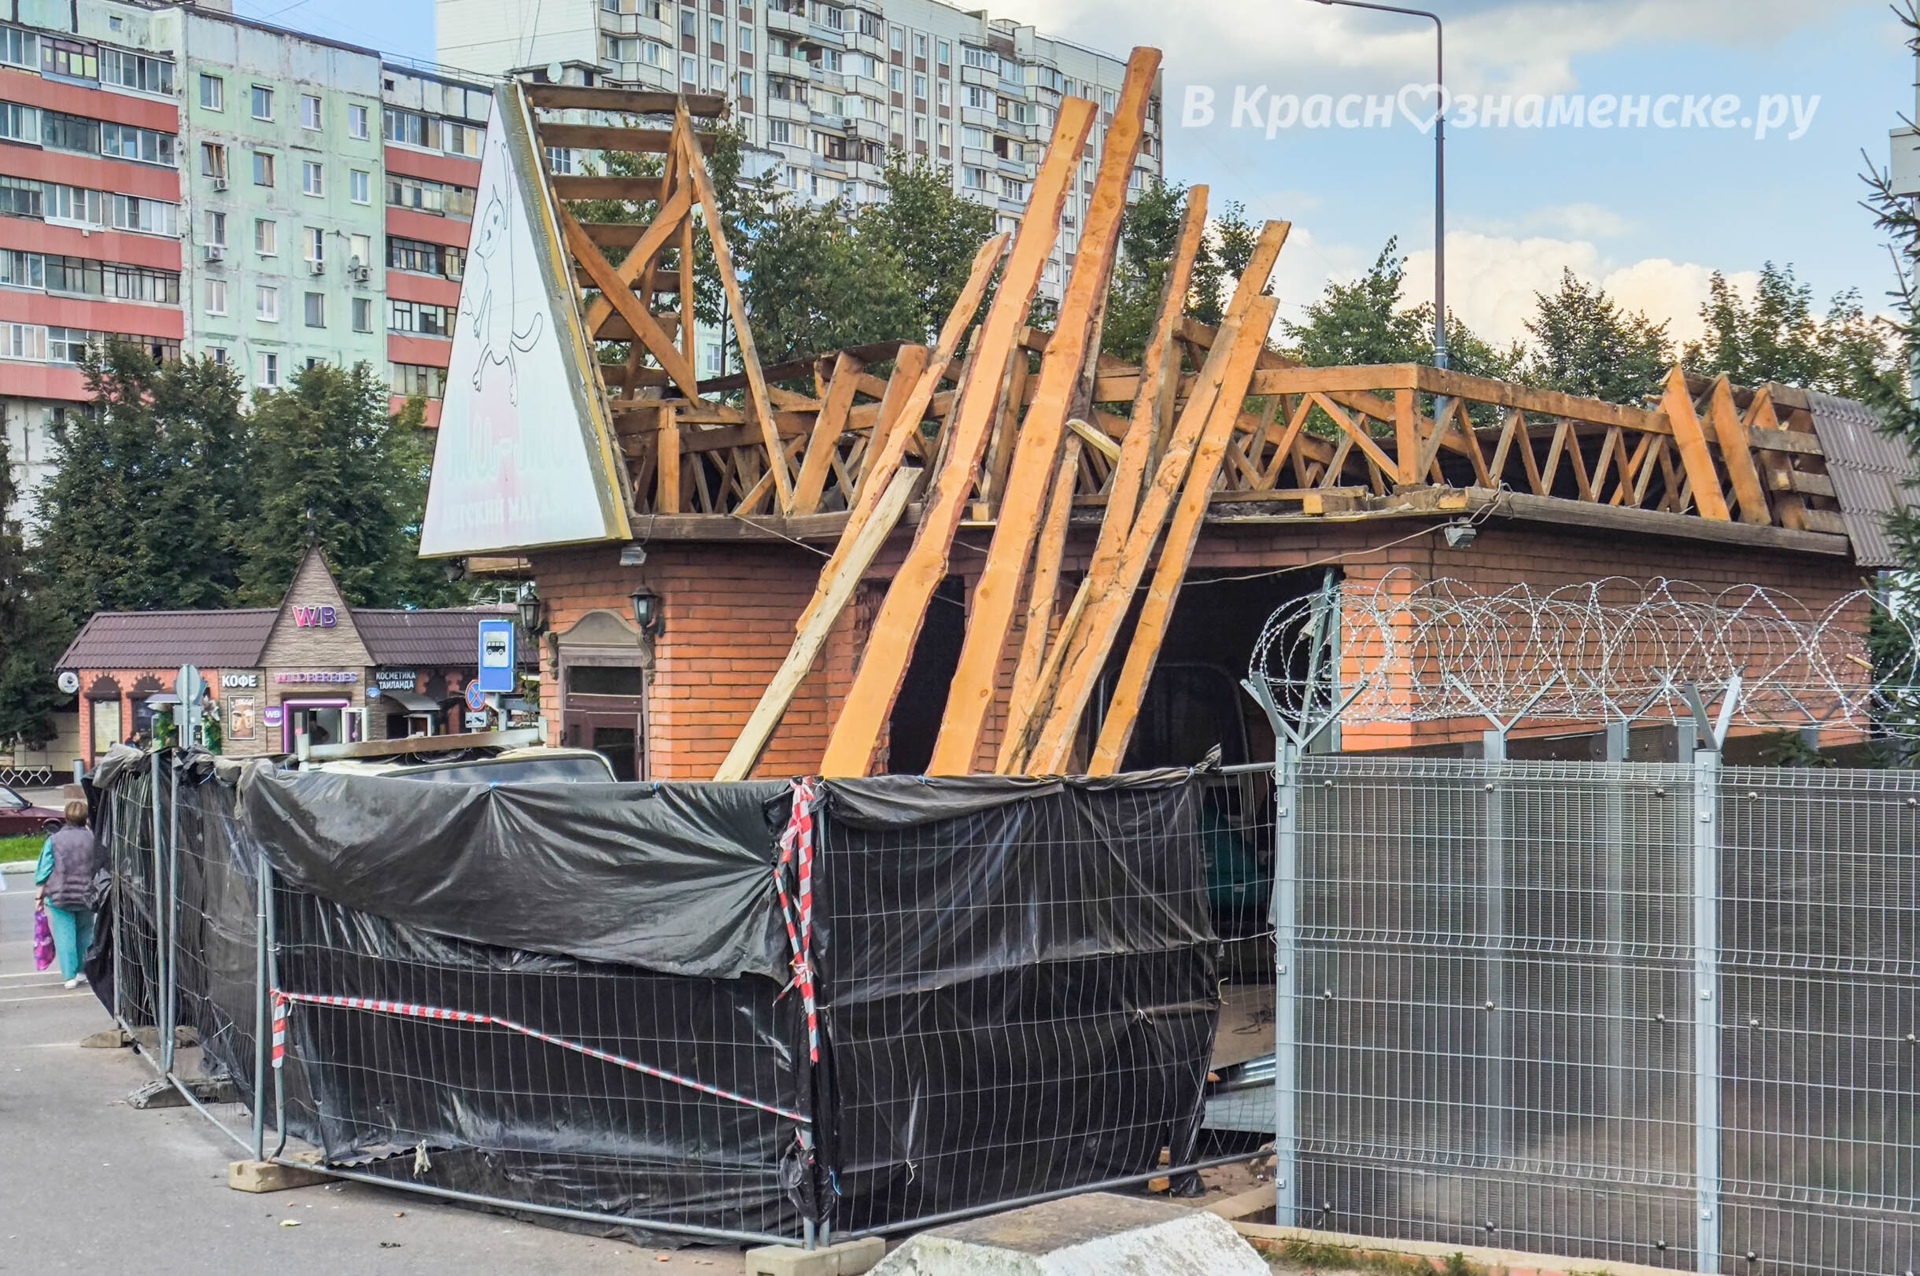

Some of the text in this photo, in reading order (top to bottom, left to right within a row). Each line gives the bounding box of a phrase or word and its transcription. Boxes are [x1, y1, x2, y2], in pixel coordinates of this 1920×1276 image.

[292, 606, 338, 627] WB
[274, 672, 358, 683] WILDBERRIES
[375, 671, 416, 680] КОСМЕТИКА
[222, 674, 257, 688] КОФЕ
[378, 680, 415, 690] ТАИЛАНДА
[265, 710, 281, 719] WB
